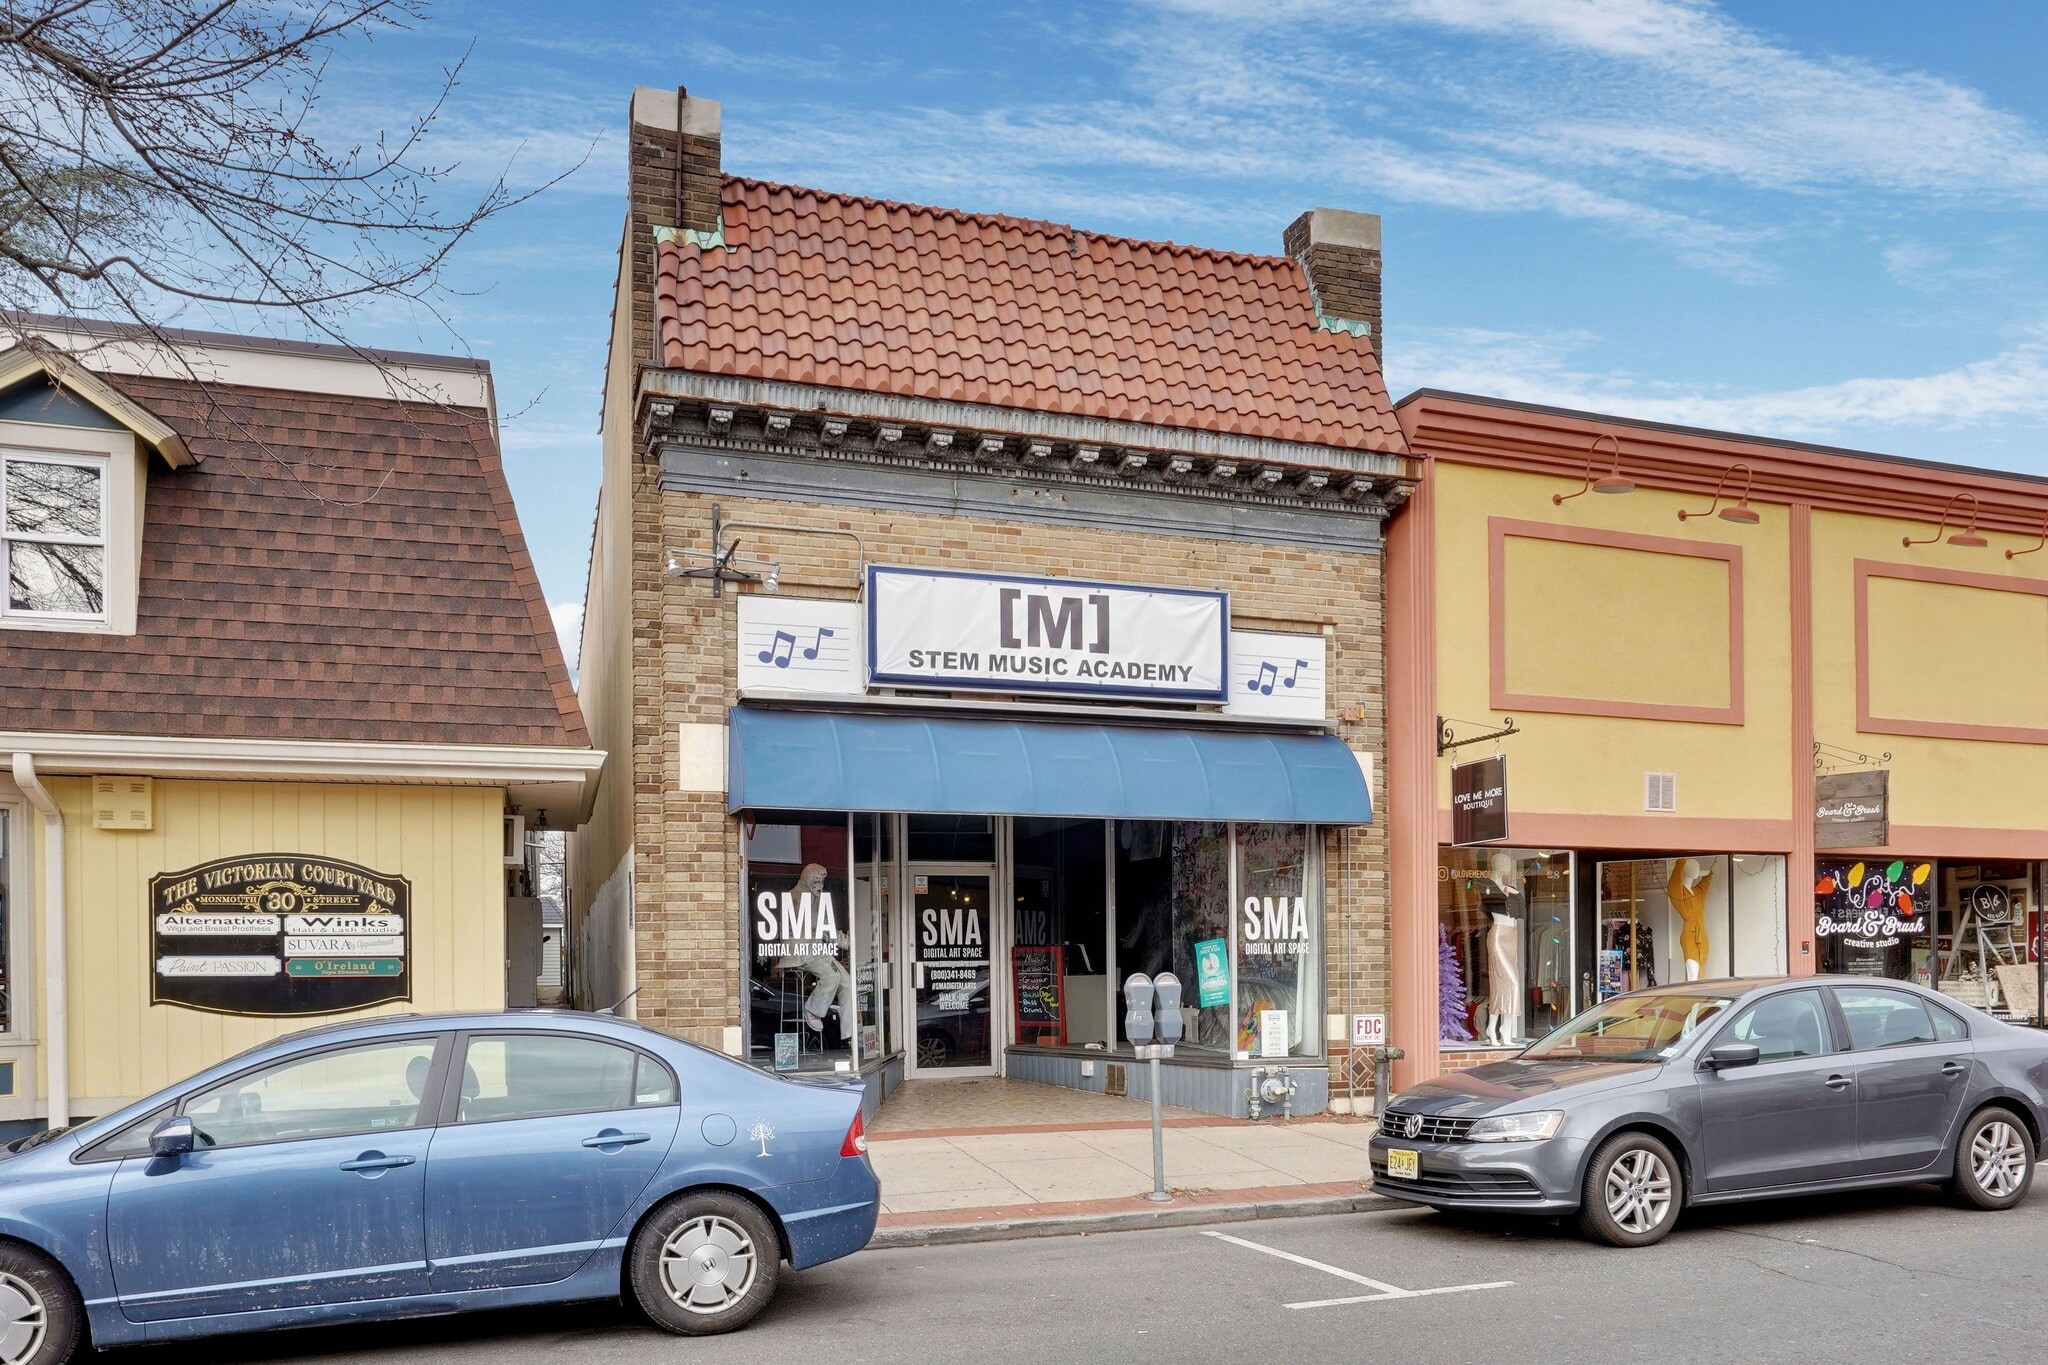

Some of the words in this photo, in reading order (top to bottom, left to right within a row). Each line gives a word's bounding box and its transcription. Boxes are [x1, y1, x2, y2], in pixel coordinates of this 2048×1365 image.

[908, 649, 979, 671] STEM
[988, 653, 1069, 676] MUSIC
[1076, 659, 1194, 683] ACADEMY
[1454, 792, 1471, 804] LOVE
[1472, 790, 1483, 801] ME
[1484, 786, 1503, 799] MORE
[1463, 798, 1494, 811] BOUTIQUE
[1816, 806, 1843, 818] Board
[1855, 804, 1881, 816] Brush
[162, 877, 198, 906] THE
[202, 862, 295, 890] VICTORIAN
[300, 863, 397, 907] COURTYARD
[200, 895, 257, 904] MONMOUTH
[265, 891, 297, 912] 30
[312, 896, 354, 904] STREET
[164, 916, 274, 925] Alternatives
[301, 917, 389, 927] Winks
[757, 891, 838, 941] SMA
[1244, 896, 1309, 940] SMA
[167, 926, 187, 934] Wigs
[922, 908, 982, 946] SMA
[1815, 916, 1863, 937] Board
[1863, 910, 1885, 937] &
[1882, 916, 1926, 937] Brush
[288, 939, 351, 950] SUVARA
[758, 943, 792, 958] DIGITAL
[793, 942, 810, 957] ART
[812, 941, 839, 957] SPACE
[1245, 942, 1272, 955] DIGITAL
[1273, 942, 1287, 954] ART
[1288, 942, 1310, 954] SPACE
[1843, 938, 1875, 949] creative
[1876, 936, 1900, 948] studio
[923, 948, 948, 959] DIGITAL
[949, 948, 961, 958] ART
[962, 947, 983, 958] SPACE
[168, 959, 208, 973] Paint
[213, 961, 267, 973] PASSION
[938, 992, 970, 1003] WALK-INS
[939, 1001, 970, 1010] WELCOME
[1356, 1018, 1382, 1035] FDC
